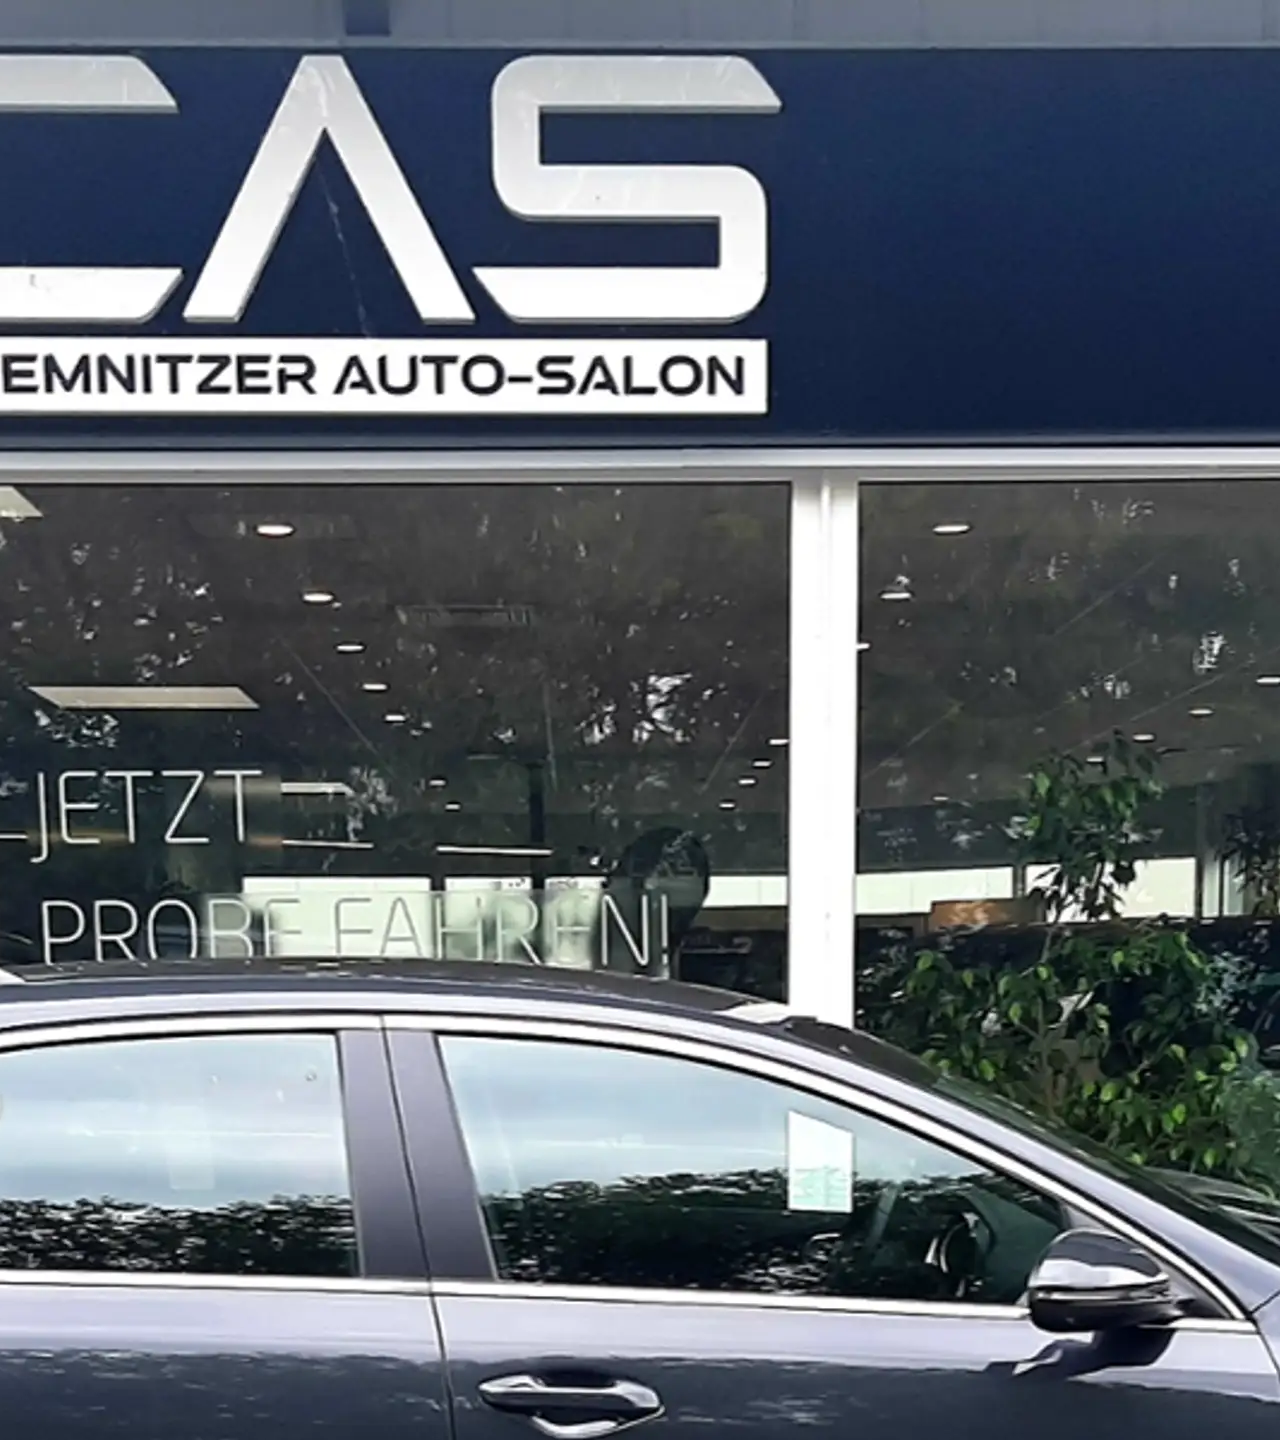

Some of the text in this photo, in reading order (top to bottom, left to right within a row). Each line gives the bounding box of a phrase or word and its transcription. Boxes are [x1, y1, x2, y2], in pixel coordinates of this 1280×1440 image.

[333, 354, 746, 397] AUTO-SALON
[30, 769, 263, 864] JETZT
[41, 893, 669, 966] PROBE FAHREN!
